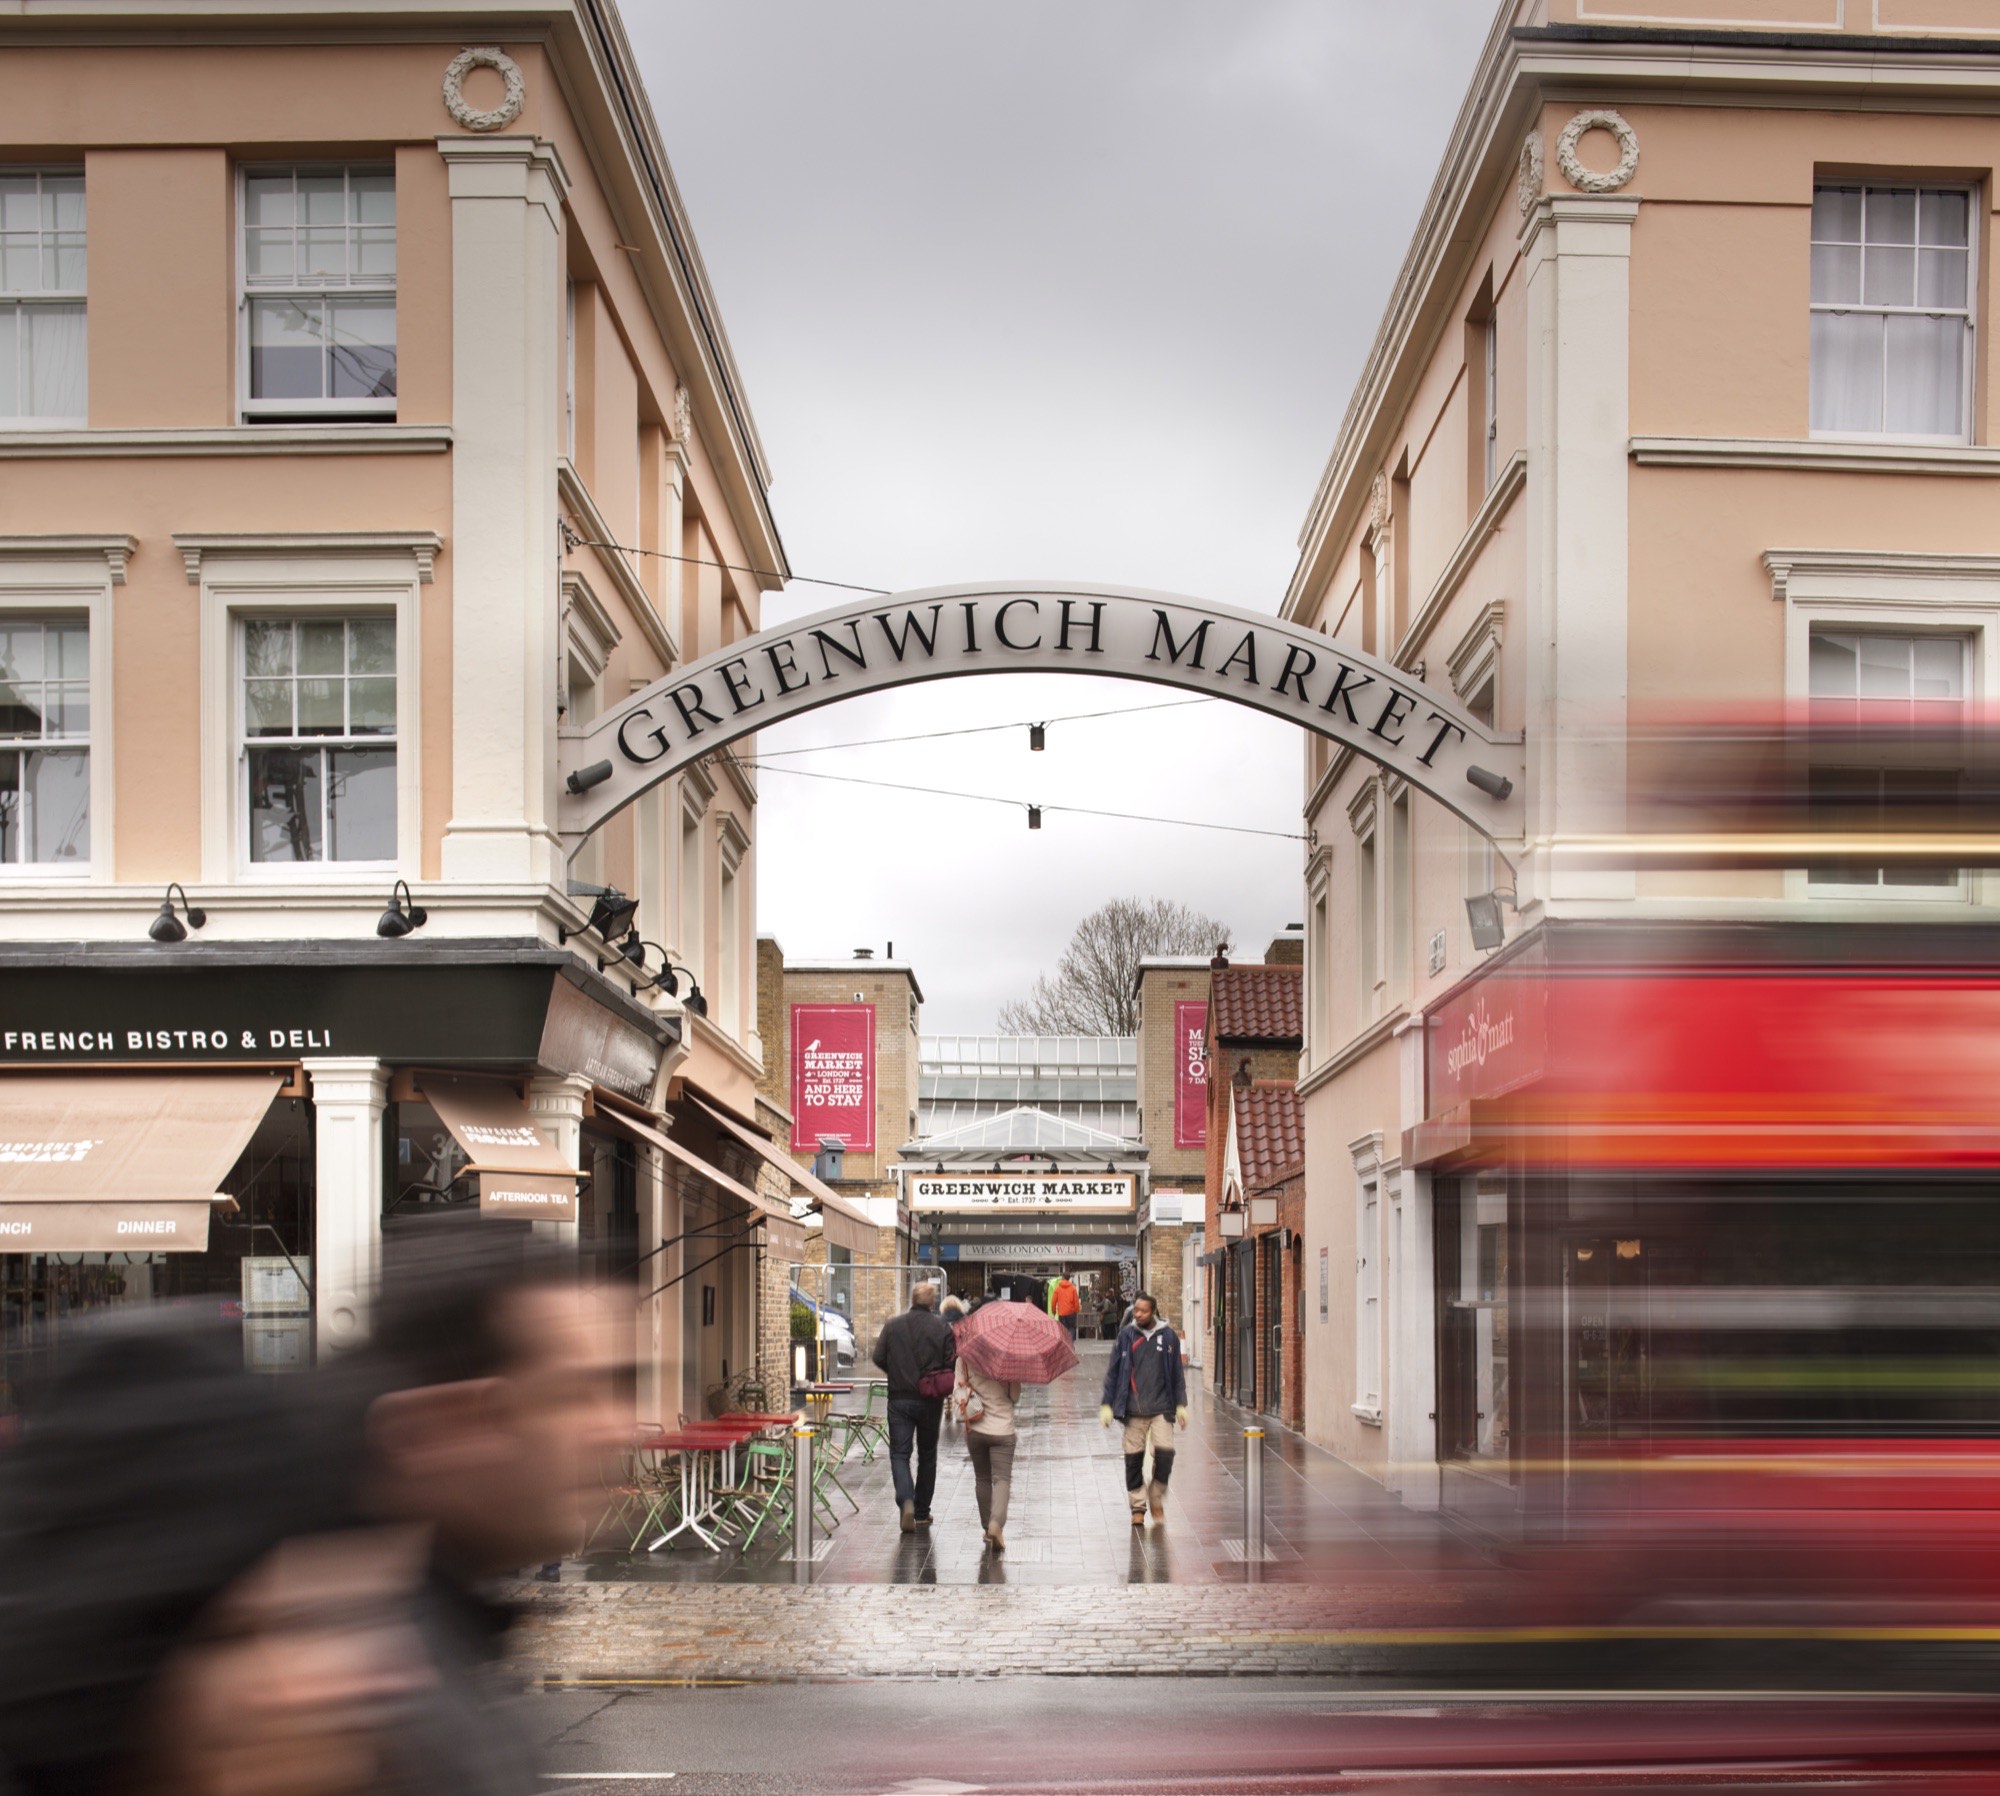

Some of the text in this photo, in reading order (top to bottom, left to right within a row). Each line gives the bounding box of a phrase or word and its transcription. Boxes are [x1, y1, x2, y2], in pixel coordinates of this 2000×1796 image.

[616, 599, 1466, 769] GREENWICH MARKET
[4, 1029, 331, 1050] FRENCH BISTRO & DELI
[1448, 1029, 1477, 1081] sophia
[1488, 1010, 1514, 1053] matt
[804, 1052, 863, 1060] GREENWICH
[804, 1060, 863, 1070] MARKET
[805, 1084, 863, 1094] AND HERE
[804, 1094, 863, 1106] TO STAY
[431, 1133, 466, 1161] 34
[919, 1183, 1126, 1195] GREENWICH MARKET
[489, 1191, 568, 1204] AFTERNOON TEA
[117, 1221, 176, 1233] DINNER
[972, 1246, 1006, 1254] WEARS
[1009, 1246, 1051, 1254] LONDON
